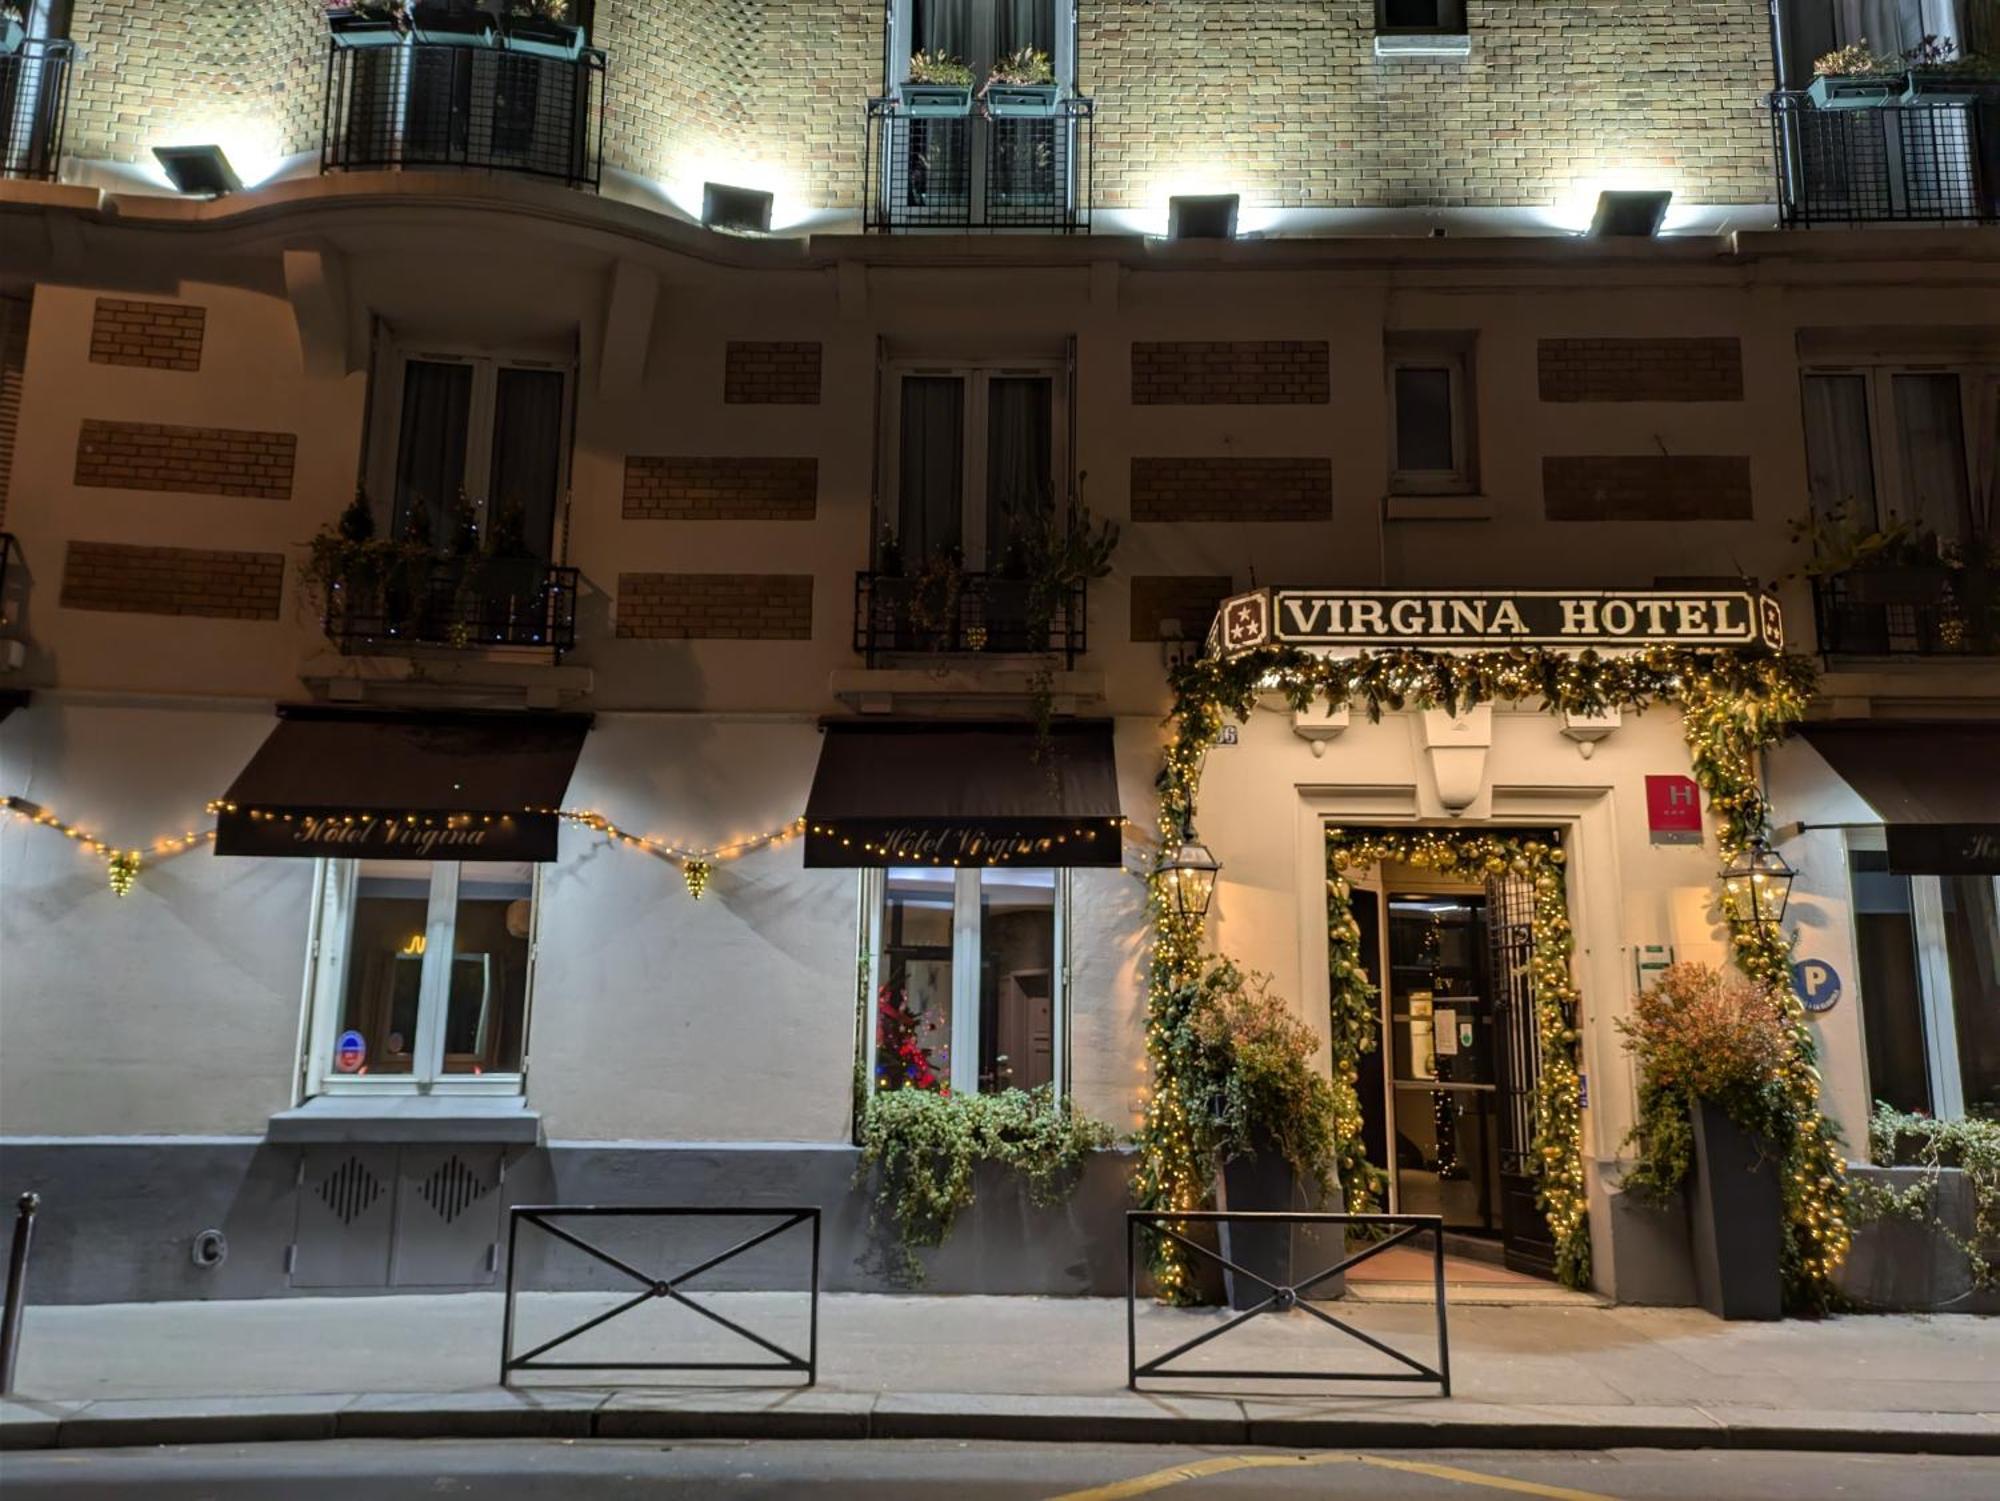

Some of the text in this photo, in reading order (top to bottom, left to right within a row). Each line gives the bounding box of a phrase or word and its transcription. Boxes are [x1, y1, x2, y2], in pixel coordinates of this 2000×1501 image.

[1284, 599, 1746, 635] VIRGINA HOTEL
[1669, 785, 1692, 806] H
[1804, 966, 1827, 996] P
